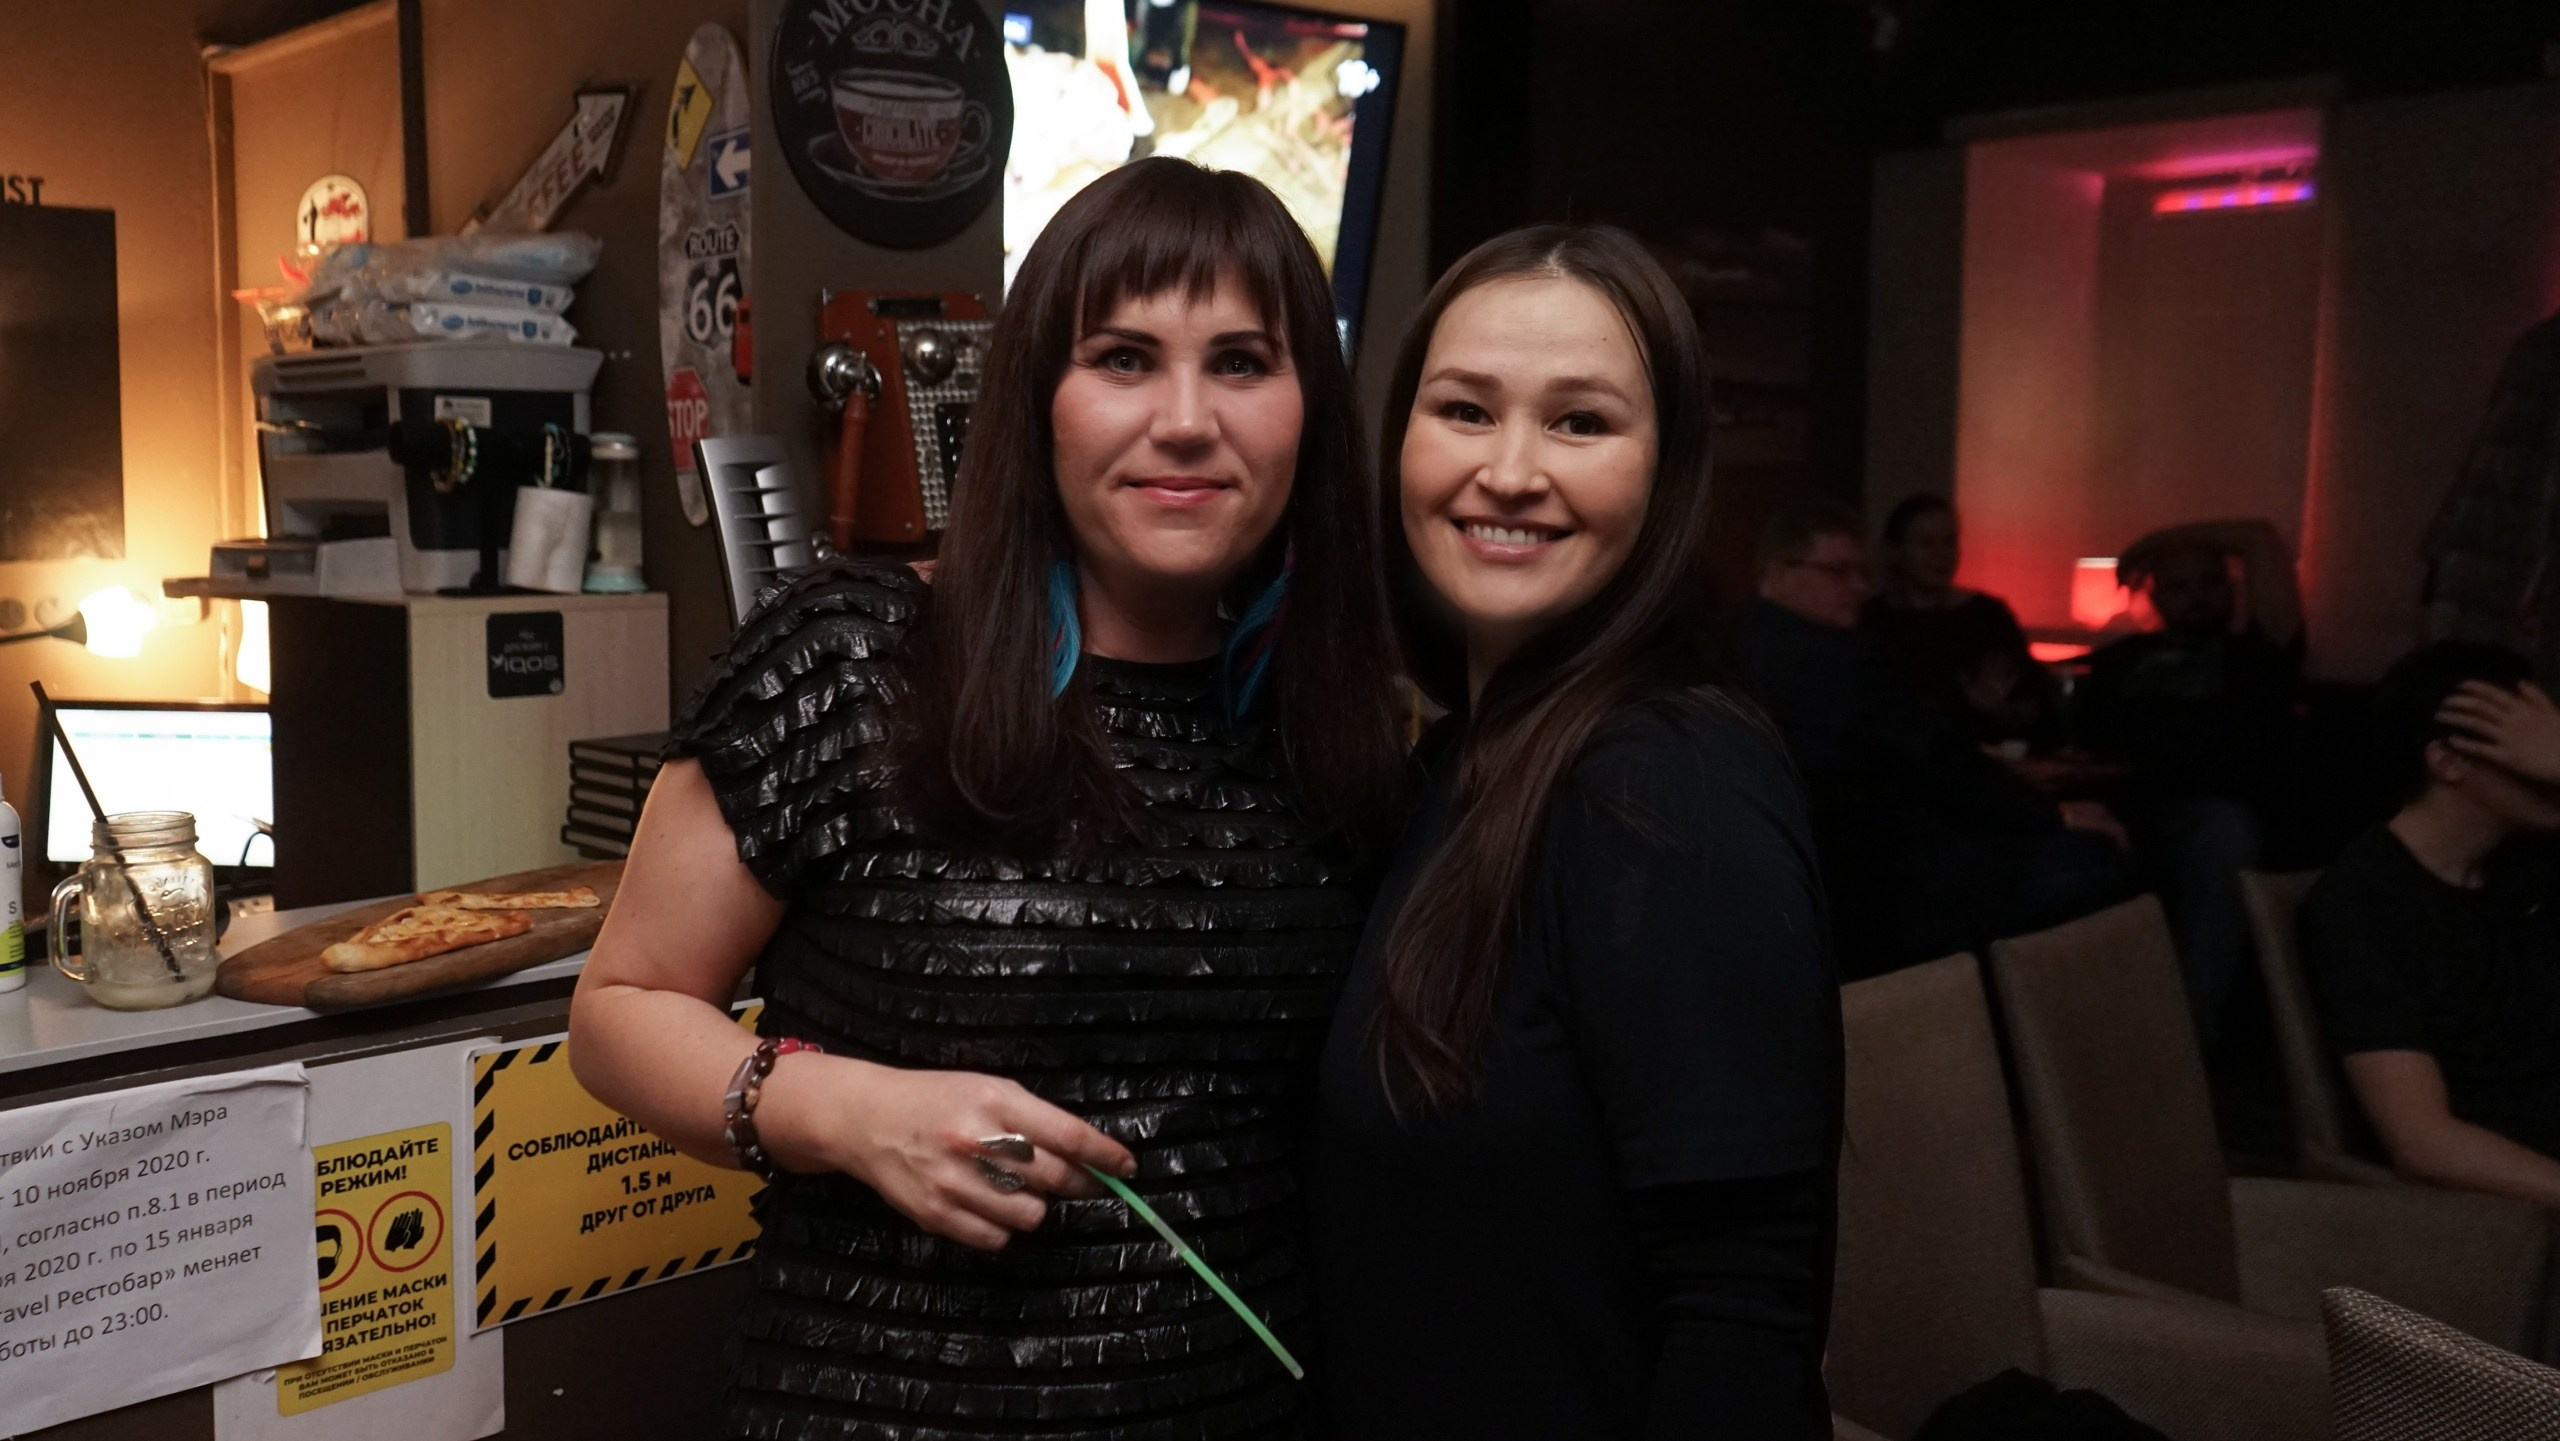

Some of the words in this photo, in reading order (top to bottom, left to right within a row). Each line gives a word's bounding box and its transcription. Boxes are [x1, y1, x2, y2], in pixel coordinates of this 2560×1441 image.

[688, 229, 737, 257] ROUTE
[690, 272, 737, 342] 66
[62, 1140, 73, 1155] с
[80, 1122, 163, 1151] Указом
[171, 1106, 227, 1131] Мэра
[12, 1185, 40, 1208] 10
[48, 1168, 129, 1200] ноября
[137, 1150, 189, 1178] 2020
[197, 1150, 210, 1165] г.
[317, 1138, 439, 1177] БЛЮДАЙТЕ
[321, 1165, 407, 1198] РЕЖИМ!
[621, 1171, 651, 1195] 1.5
[16, 1211, 120, 1248] согласно
[128, 1193, 180, 1220] п.8.1
[188, 1192, 199, 1206] в
[207, 1172, 286, 1201] период
[581, 1205, 628, 1234] ДРУГ
[632, 1198, 657, 1218] ОТ
[660, 1184, 716, 1215] ДРУГА
[0, 1272, 16, 1289] я
[24, 1252, 80, 1282] 2020
[88, 1251, 102, 1266] г.
[111, 1242, 137, 1259] по
[146, 1230, 170, 1251] 15
[177, 1214, 253, 1244] января
[58, 1268, 176, 1310] Рестобар»
[183, 1246, 262, 1278] меняет
[383, 1273, 447, 1301] МАСКИ
[63, 1325, 93, 1349] до
[101, 1303, 168, 1335] 23:00.
[322, 1312, 437, 1354] ЯЗАТЕЛЬНО!
[326, 1297, 424, 1334] ПЕРЧАТОК
[283, 1375, 302, 1387] ПРИ
[304, 1358, 361, 1381] ОТСУТСТВИИ
[362, 1350, 393, 1364] МАСКИ
[395, 1347, 401, 1355] И
[403, 1336, 448, 1353] ПЕРЧАТОК
[298, 1380, 319, 1391] ВАМ
[320, 1369, 353, 1384] МОЖЕТ
[354, 1363, 379, 1375] БЫТЬ
[380, 1349, 427, 1368] ОТКАЗАНО
[298, 1378, 355, 1400] ПОСЕЩЕНИИ
[361, 1356, 435, 1381] ОБСЛУЖИВАНИИ
